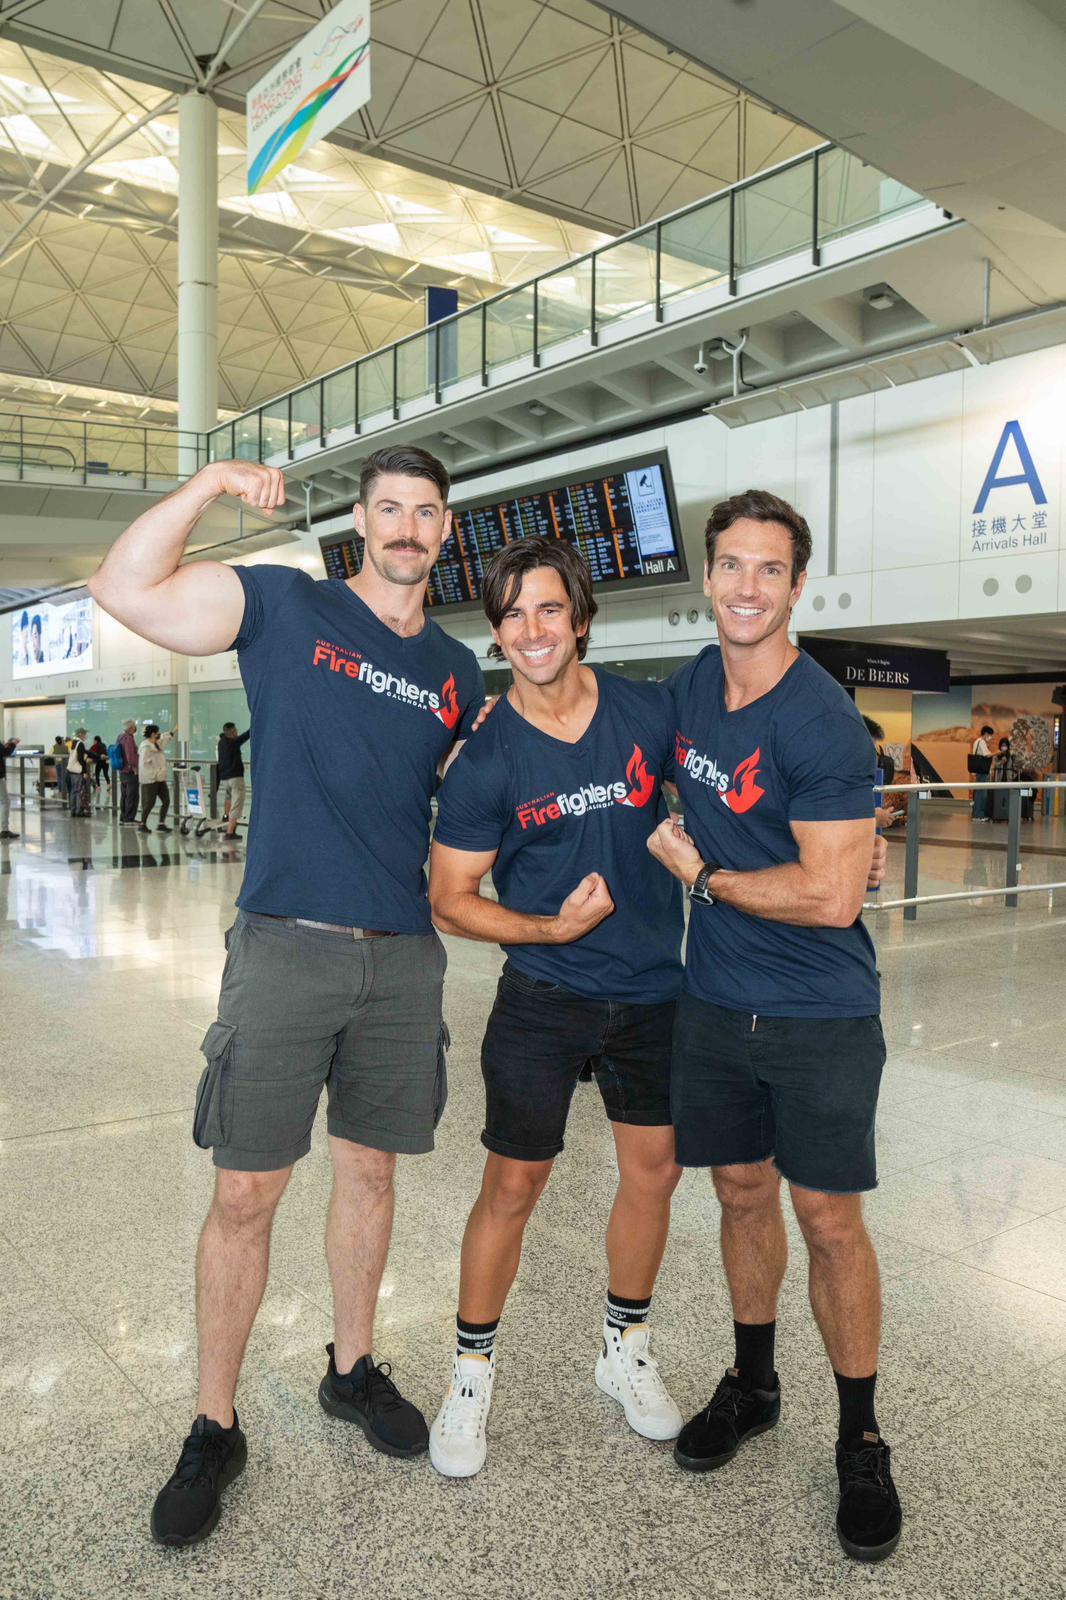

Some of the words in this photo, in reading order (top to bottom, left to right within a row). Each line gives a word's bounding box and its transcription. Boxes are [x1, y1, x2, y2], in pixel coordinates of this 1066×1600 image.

[972, 420, 1048, 514] A
[972, 510, 1048, 539] 接機大堂
[972, 535, 1019, 552] Arrivals
[1023, 532, 1047, 547] Hall
[645, 561, 665, 576] Hall
[667, 558, 676, 572] A
[315, 639, 363, 660] AUSTRALIAN
[313, 645, 440, 710] Firefighters
[846, 666, 865, 681] DE
[869, 667, 910, 685] BEERS
[386, 692, 428, 710] CALENDAR
[515, 791, 556, 811] AUSTRALIAN
